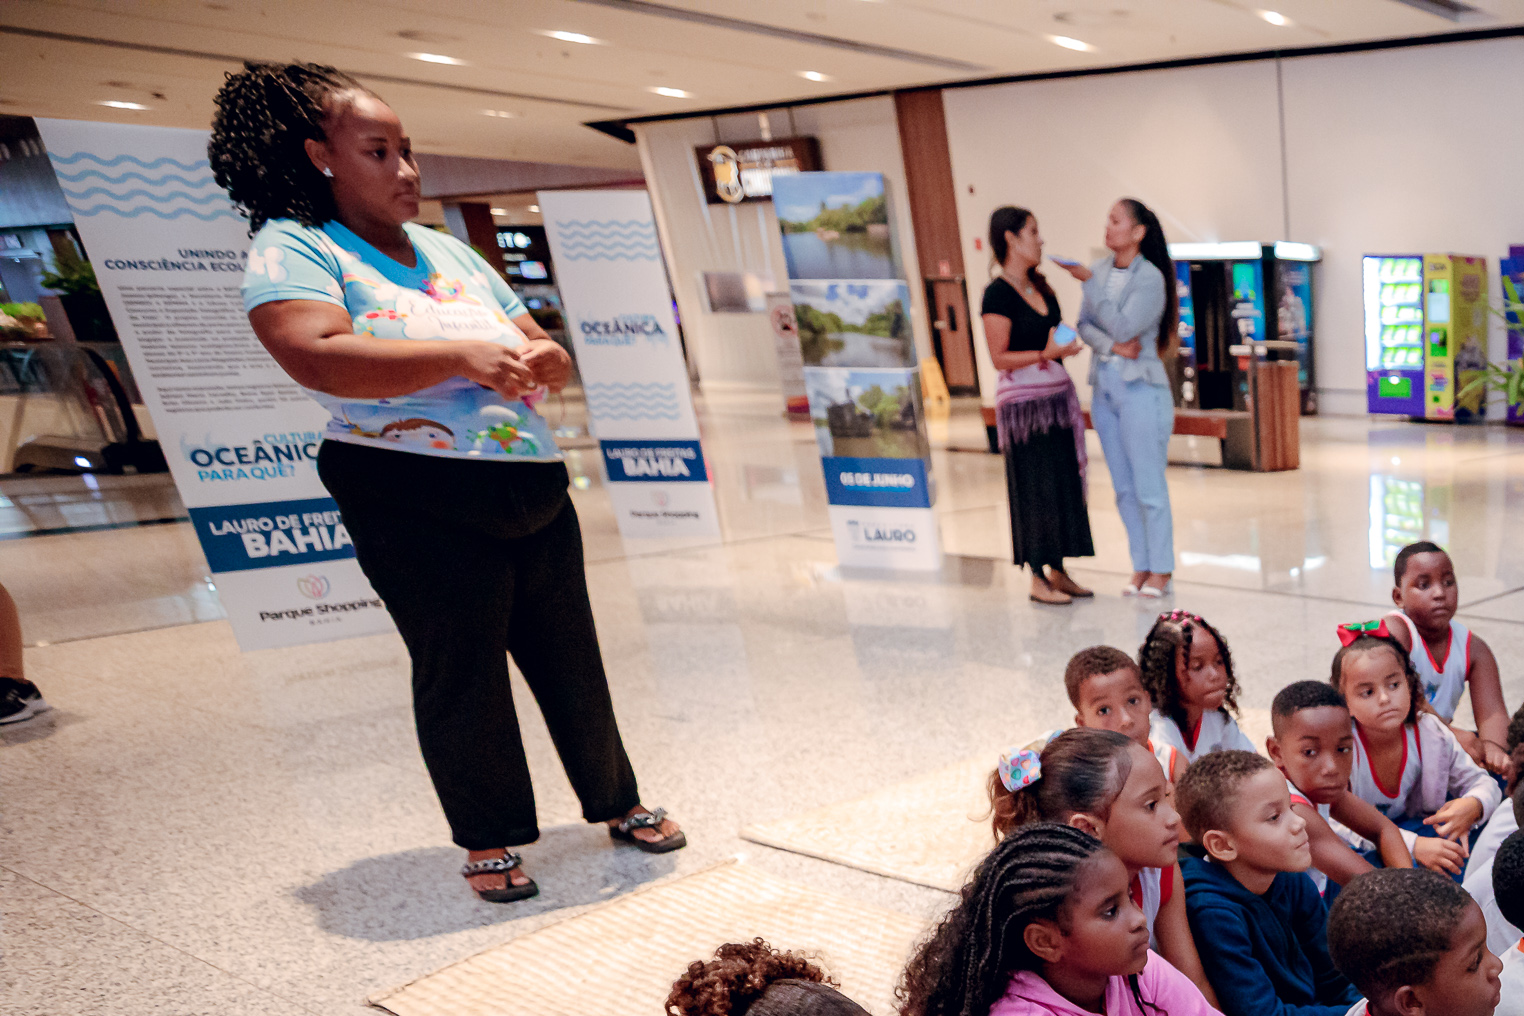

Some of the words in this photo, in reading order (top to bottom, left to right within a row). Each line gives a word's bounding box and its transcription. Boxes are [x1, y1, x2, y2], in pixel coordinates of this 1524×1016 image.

[104, 256, 208, 272] CONSCIÊNCIA
[177, 248, 237, 260] UNINDO
[580, 319, 665, 336] OCEÂNICA
[190, 439, 319, 468] OCEÂNIC
[196, 467, 250, 483] PARA
[250, 460, 296, 481] QUÊ?
[620, 457, 691, 477] BAHIA
[872, 473, 915, 488] JUNHO
[208, 517, 274, 536] LAURO
[274, 514, 301, 530] DE
[863, 527, 917, 543] LAURO
[240, 523, 353, 559] BAHIA
[259, 604, 313, 622] Parque
[316, 597, 383, 616] Shopping
